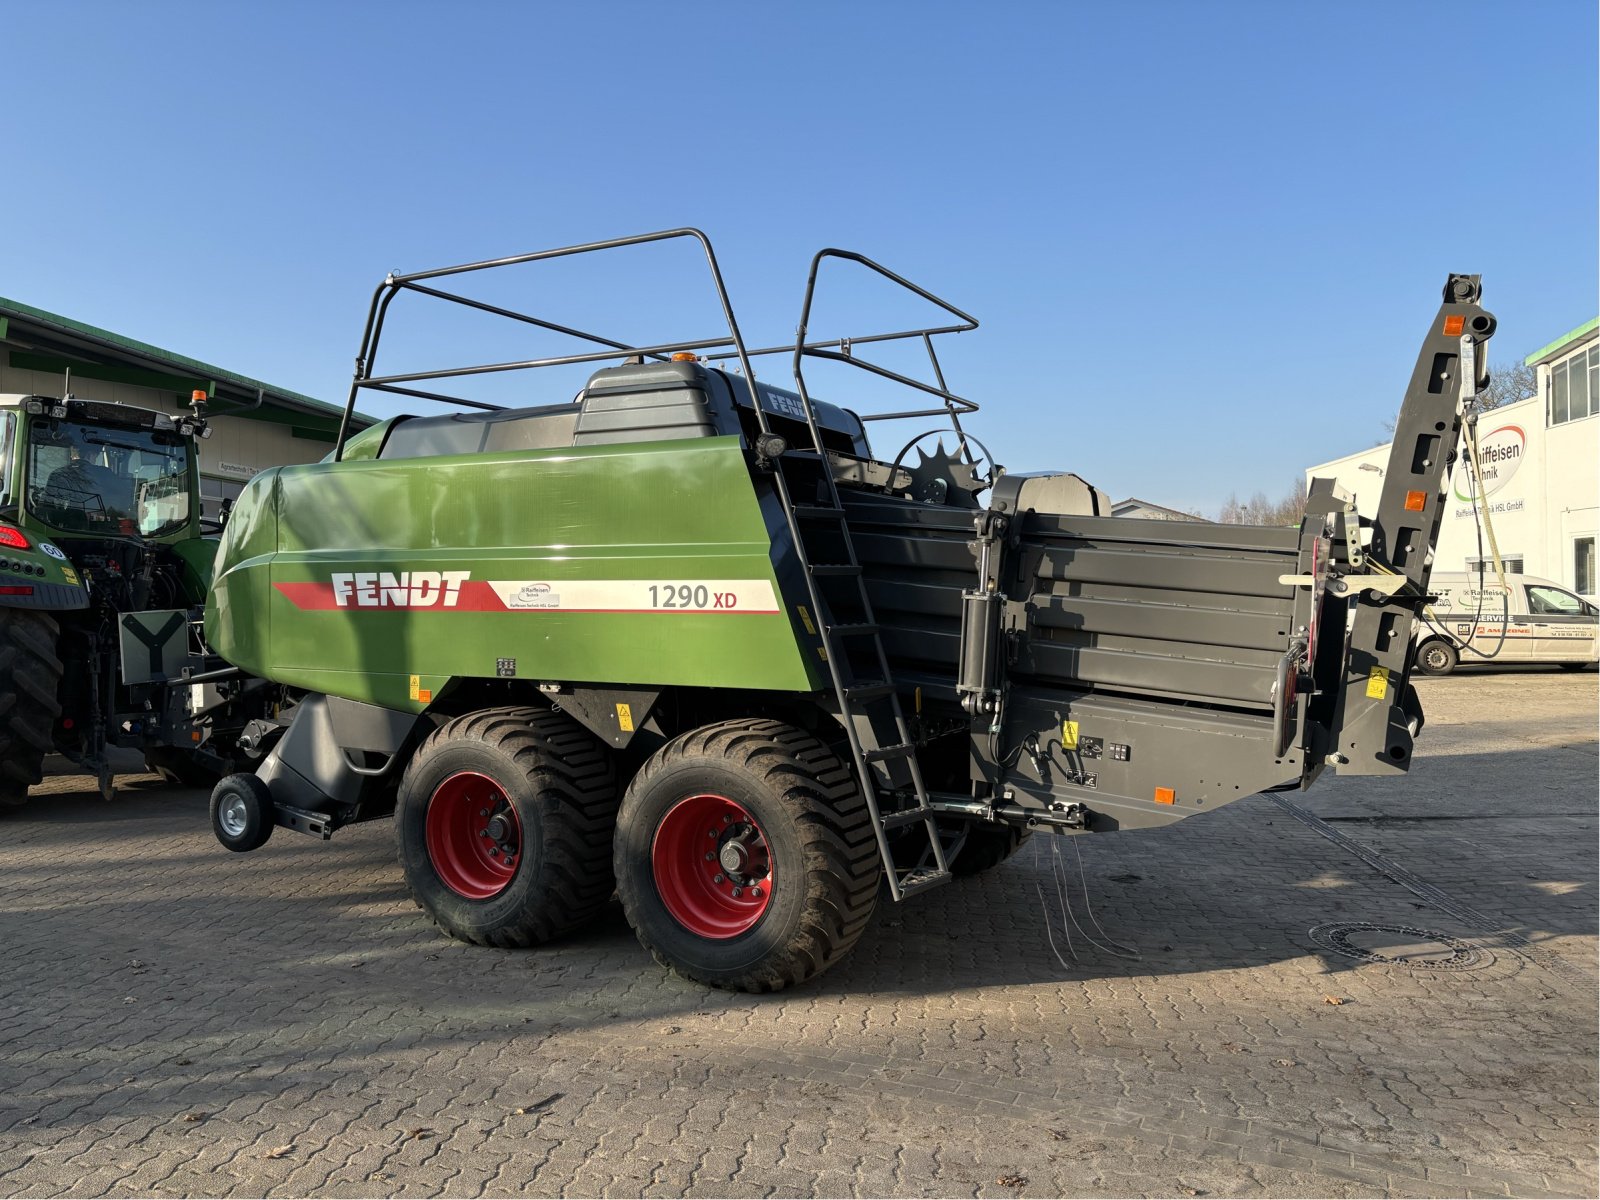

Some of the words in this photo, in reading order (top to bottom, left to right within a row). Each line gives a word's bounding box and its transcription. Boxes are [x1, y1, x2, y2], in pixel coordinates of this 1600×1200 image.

[1470, 443, 1520, 467] iffeisen
[43, 544, 63, 558] 60
[331, 570, 471, 607] FENDT
[648, 584, 709, 608] 1290
[713, 592, 737, 609] XD
